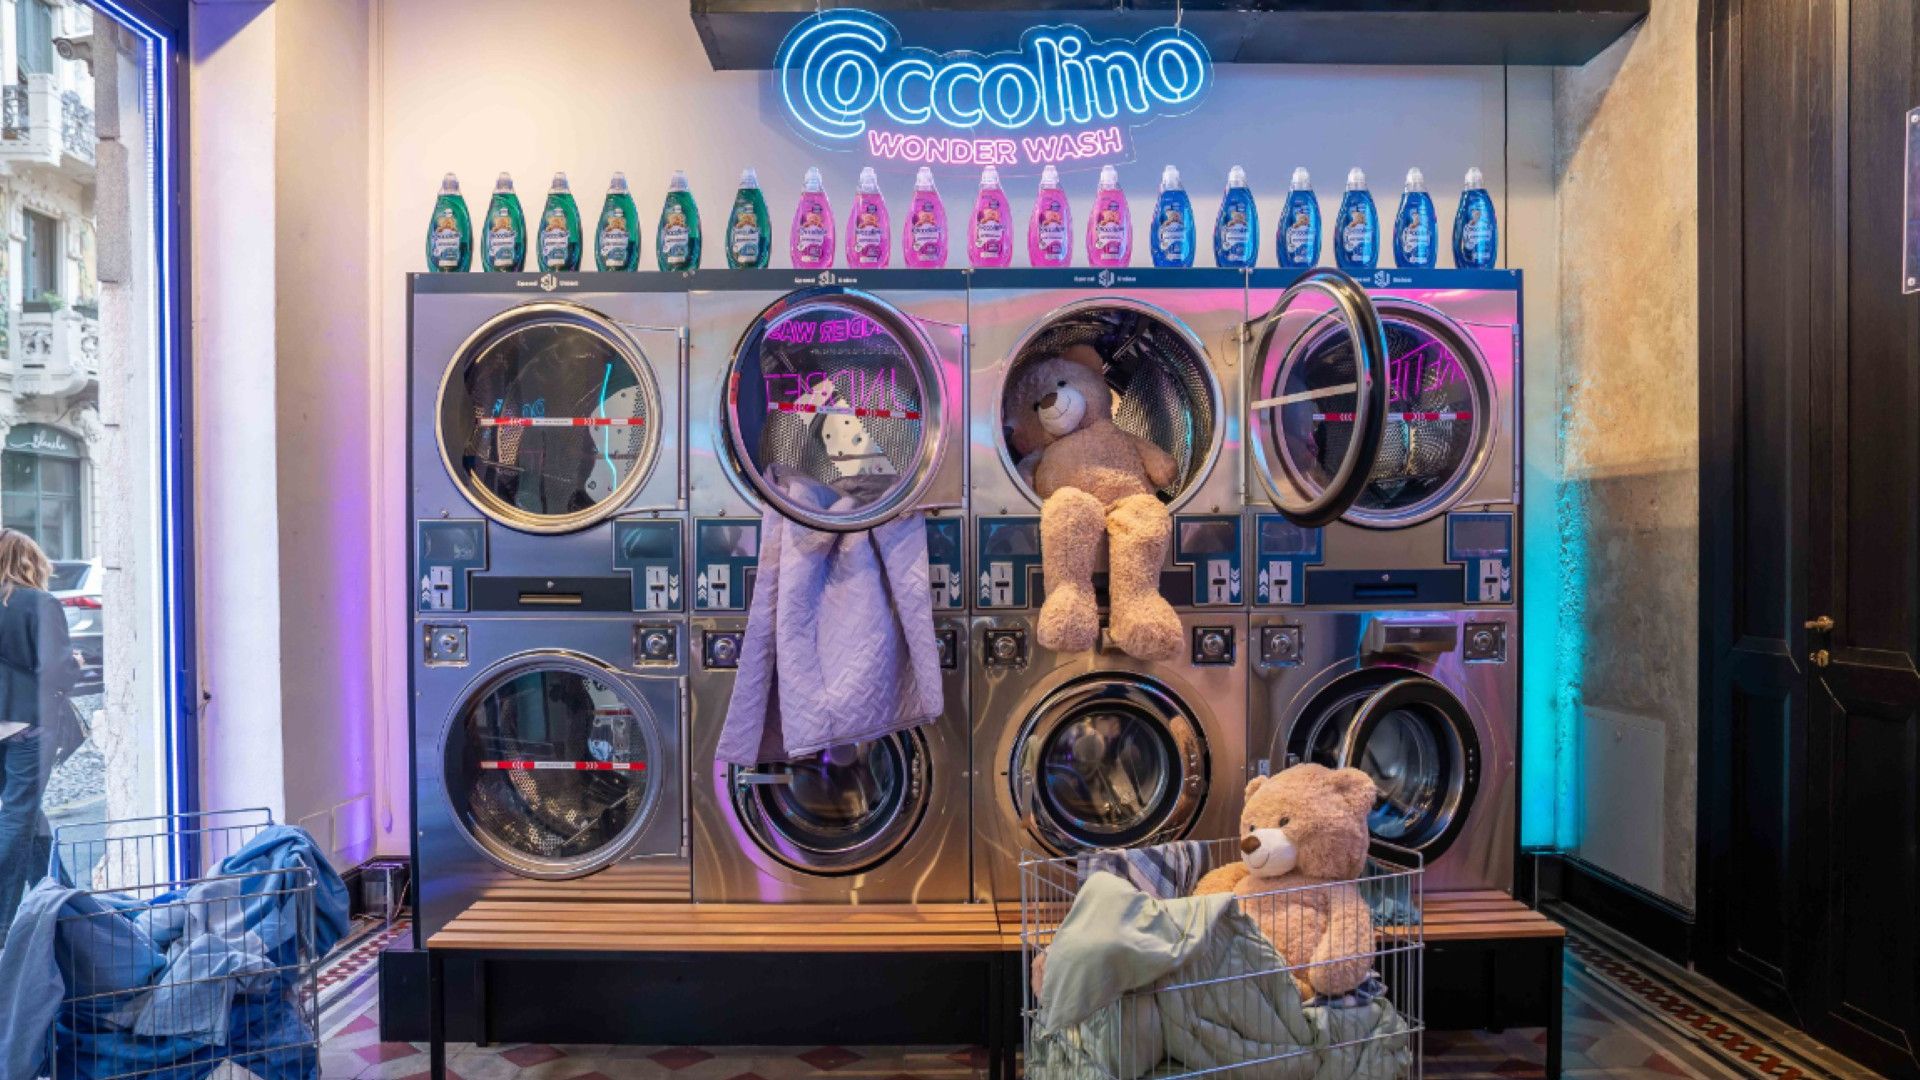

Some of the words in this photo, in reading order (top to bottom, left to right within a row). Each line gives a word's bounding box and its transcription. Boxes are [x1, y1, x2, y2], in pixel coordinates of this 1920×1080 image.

[782, 19, 1204, 138] Coccolino
[867, 129, 1018, 165] WONDER
[1021, 126, 1123, 163] WASH
